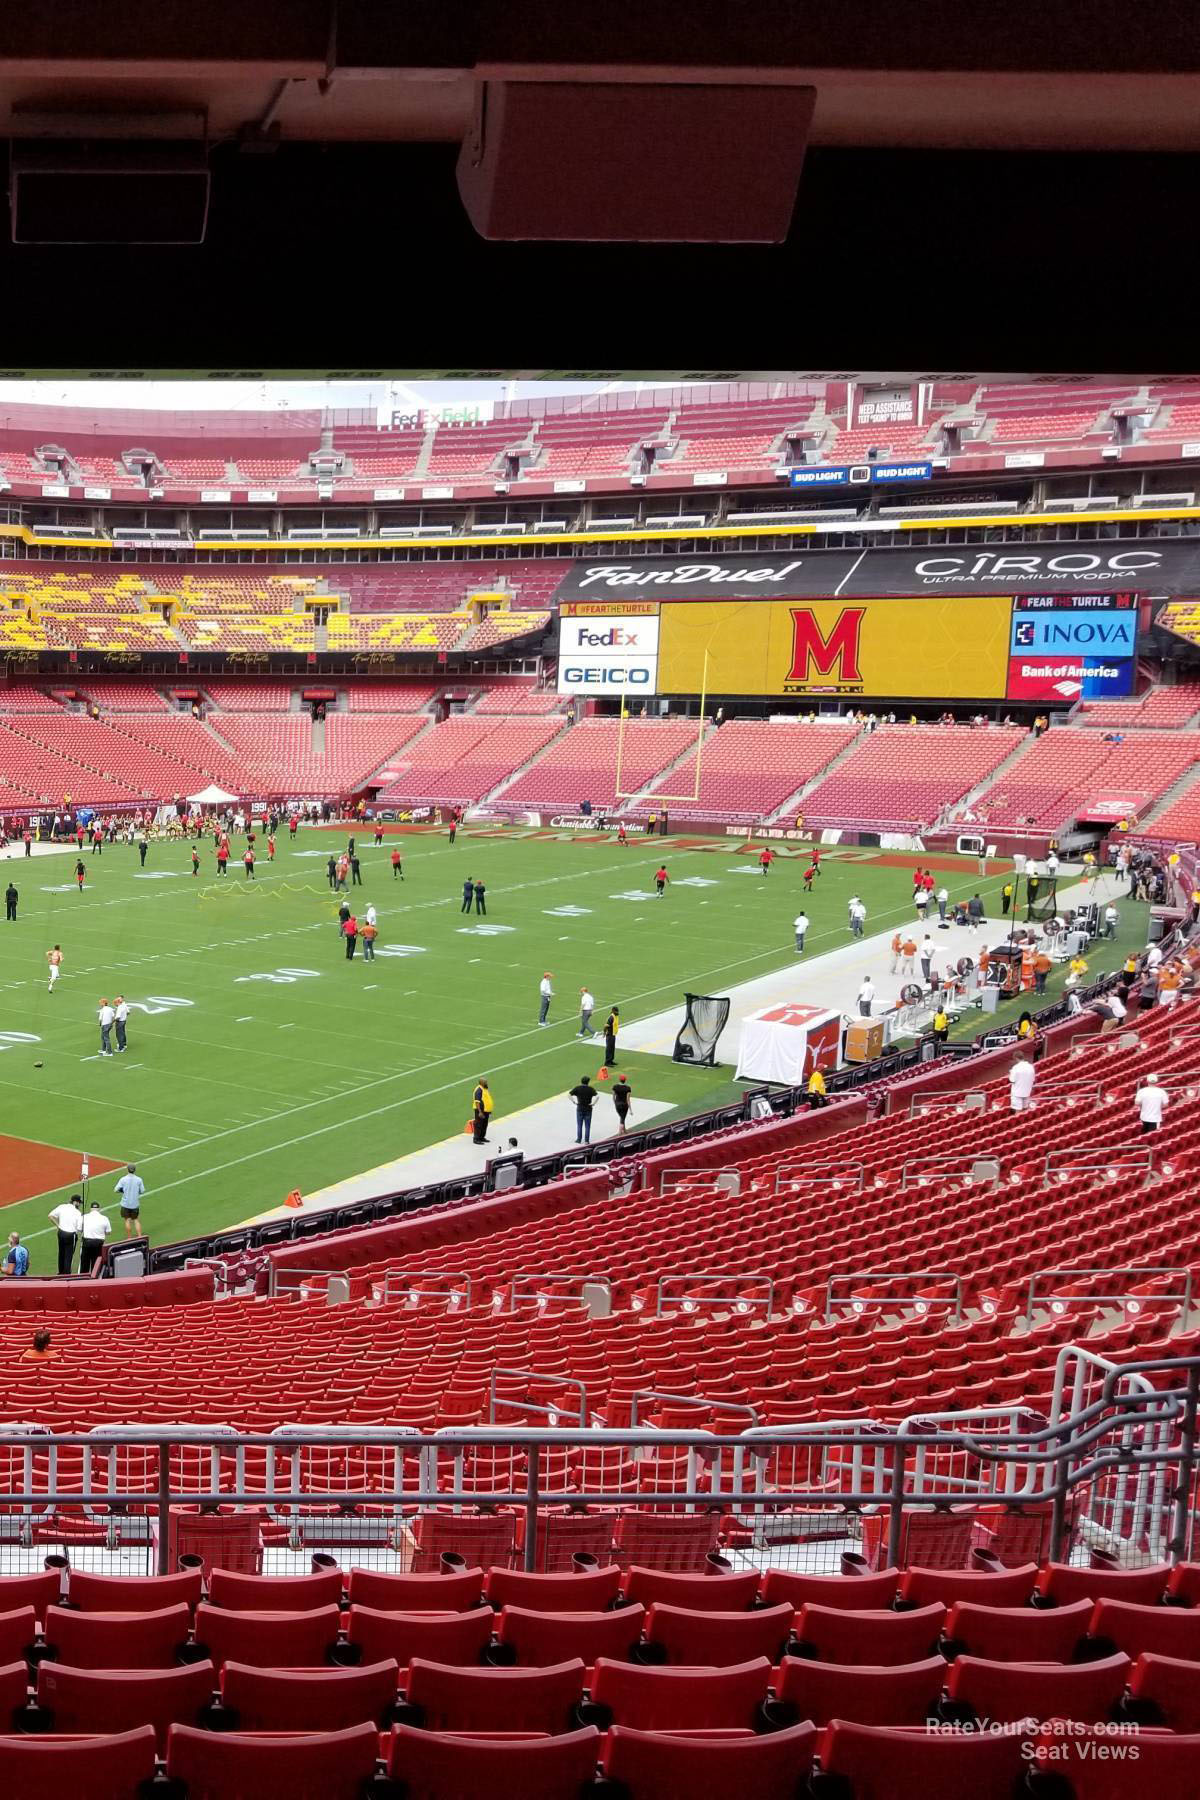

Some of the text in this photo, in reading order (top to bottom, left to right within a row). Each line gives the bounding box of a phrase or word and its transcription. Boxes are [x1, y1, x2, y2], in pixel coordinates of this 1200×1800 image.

[875, 400, 913, 414] ASSISTANCE
[795, 471, 844, 482] BUD LIGHT
[876, 466, 927, 478] BUD LIGHT
[579, 561, 802, 588] FanDuel
[923, 570, 1137, 584] ULTRA PREMIUM VODKA
[578, 628, 638, 647] FedEx
[1043, 623, 1131, 643] INOVA
[564, 667, 650, 684] GEICO
[1022, 665, 1119, 679] Bank of America
[249, 967, 320, 983] 30
[125, 996, 195, 1014] 20
